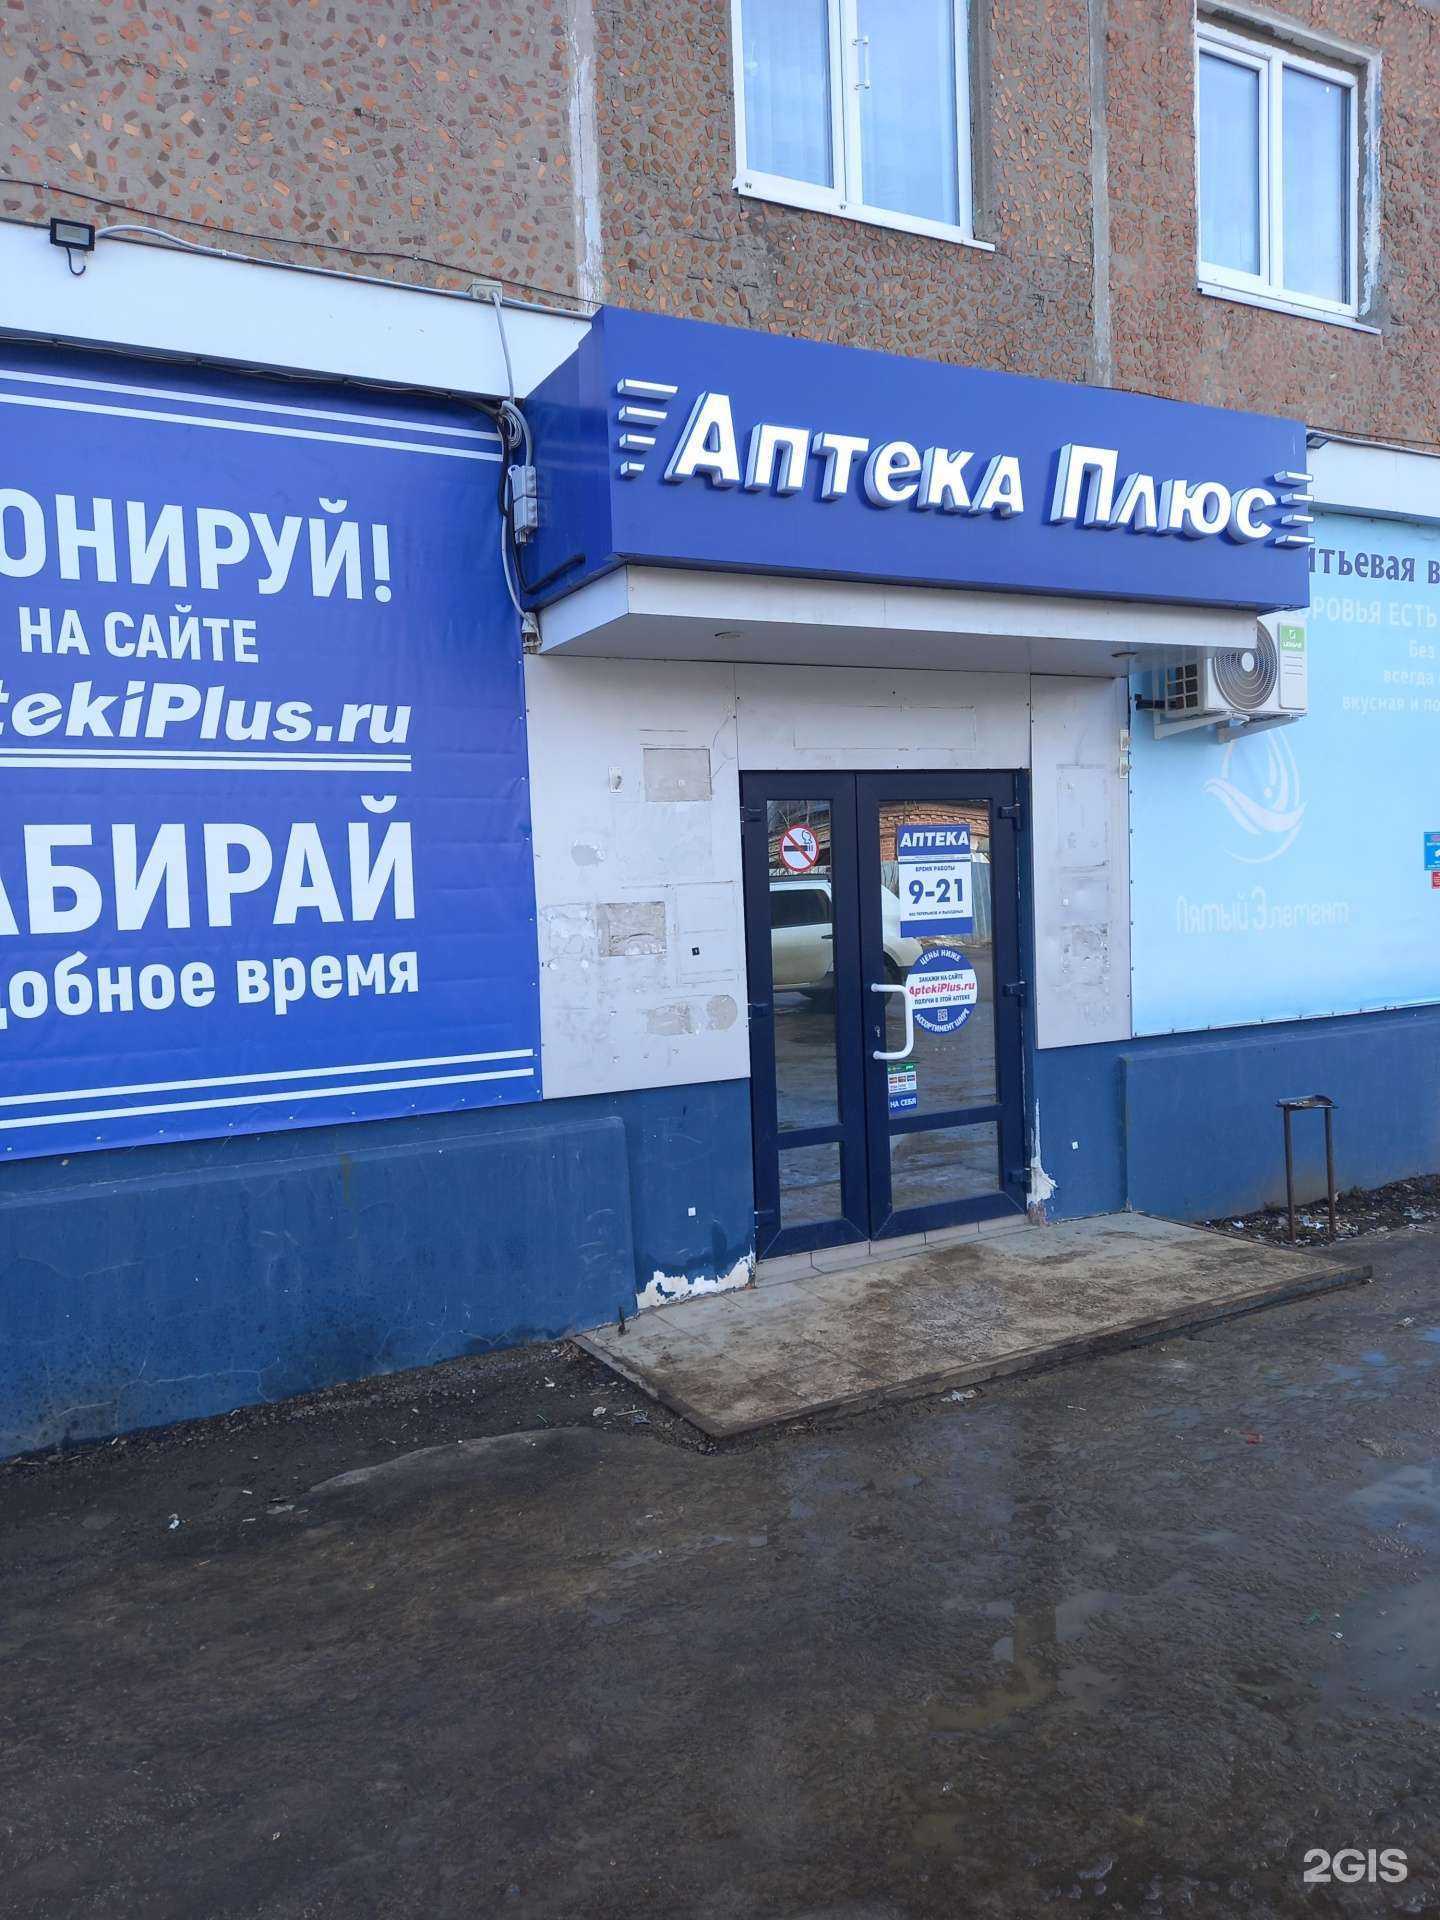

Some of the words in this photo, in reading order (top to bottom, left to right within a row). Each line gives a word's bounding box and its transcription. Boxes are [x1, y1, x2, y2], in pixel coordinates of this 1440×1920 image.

[663, 392, 1024, 518] Аптека
[1050, 442, 1277, 543] Плюс
[1306, 597, 1382, 625] РОВЬЯ
[1389, 602, 1438, 628] ЕСТЬ
[18, 606, 91, 656] НА
[104, 602, 259, 664] САЙТЕ
[900, 830, 970, 849] АПТЕКА
[908, 878, 964, 905] 9-21
[920, 949, 939, 966] ЦЕНЫ
[941, 949, 961, 962] НИЖЕ
[236, 951, 419, 1016] время
[914, 1013, 954, 1032] АССОРТИМЕНТ
